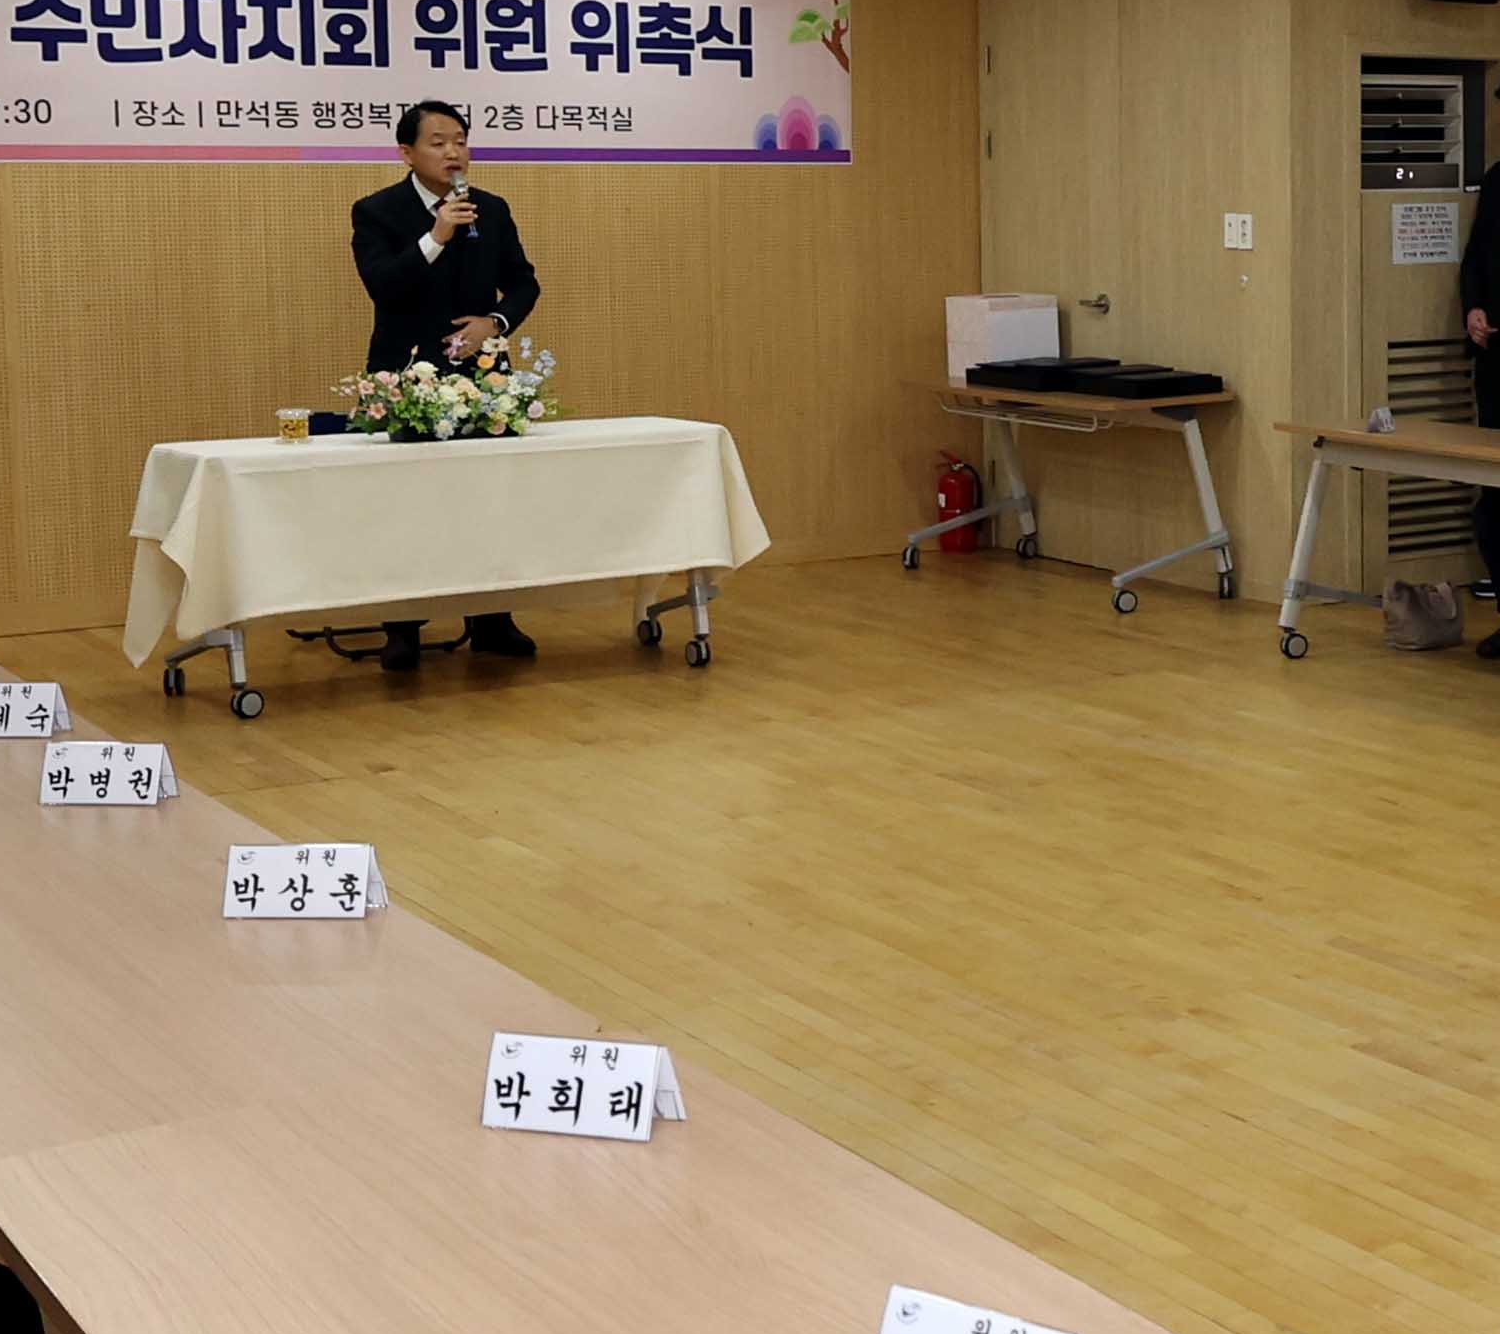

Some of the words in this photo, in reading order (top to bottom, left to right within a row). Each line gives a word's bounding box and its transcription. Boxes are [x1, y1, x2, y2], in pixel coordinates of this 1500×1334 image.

[570, 0, 754, 78] 위촉식
[217, 100, 300, 129] 만석동
[484, 104, 525, 131] 2층
[536, 105, 633, 132] 다목적실
